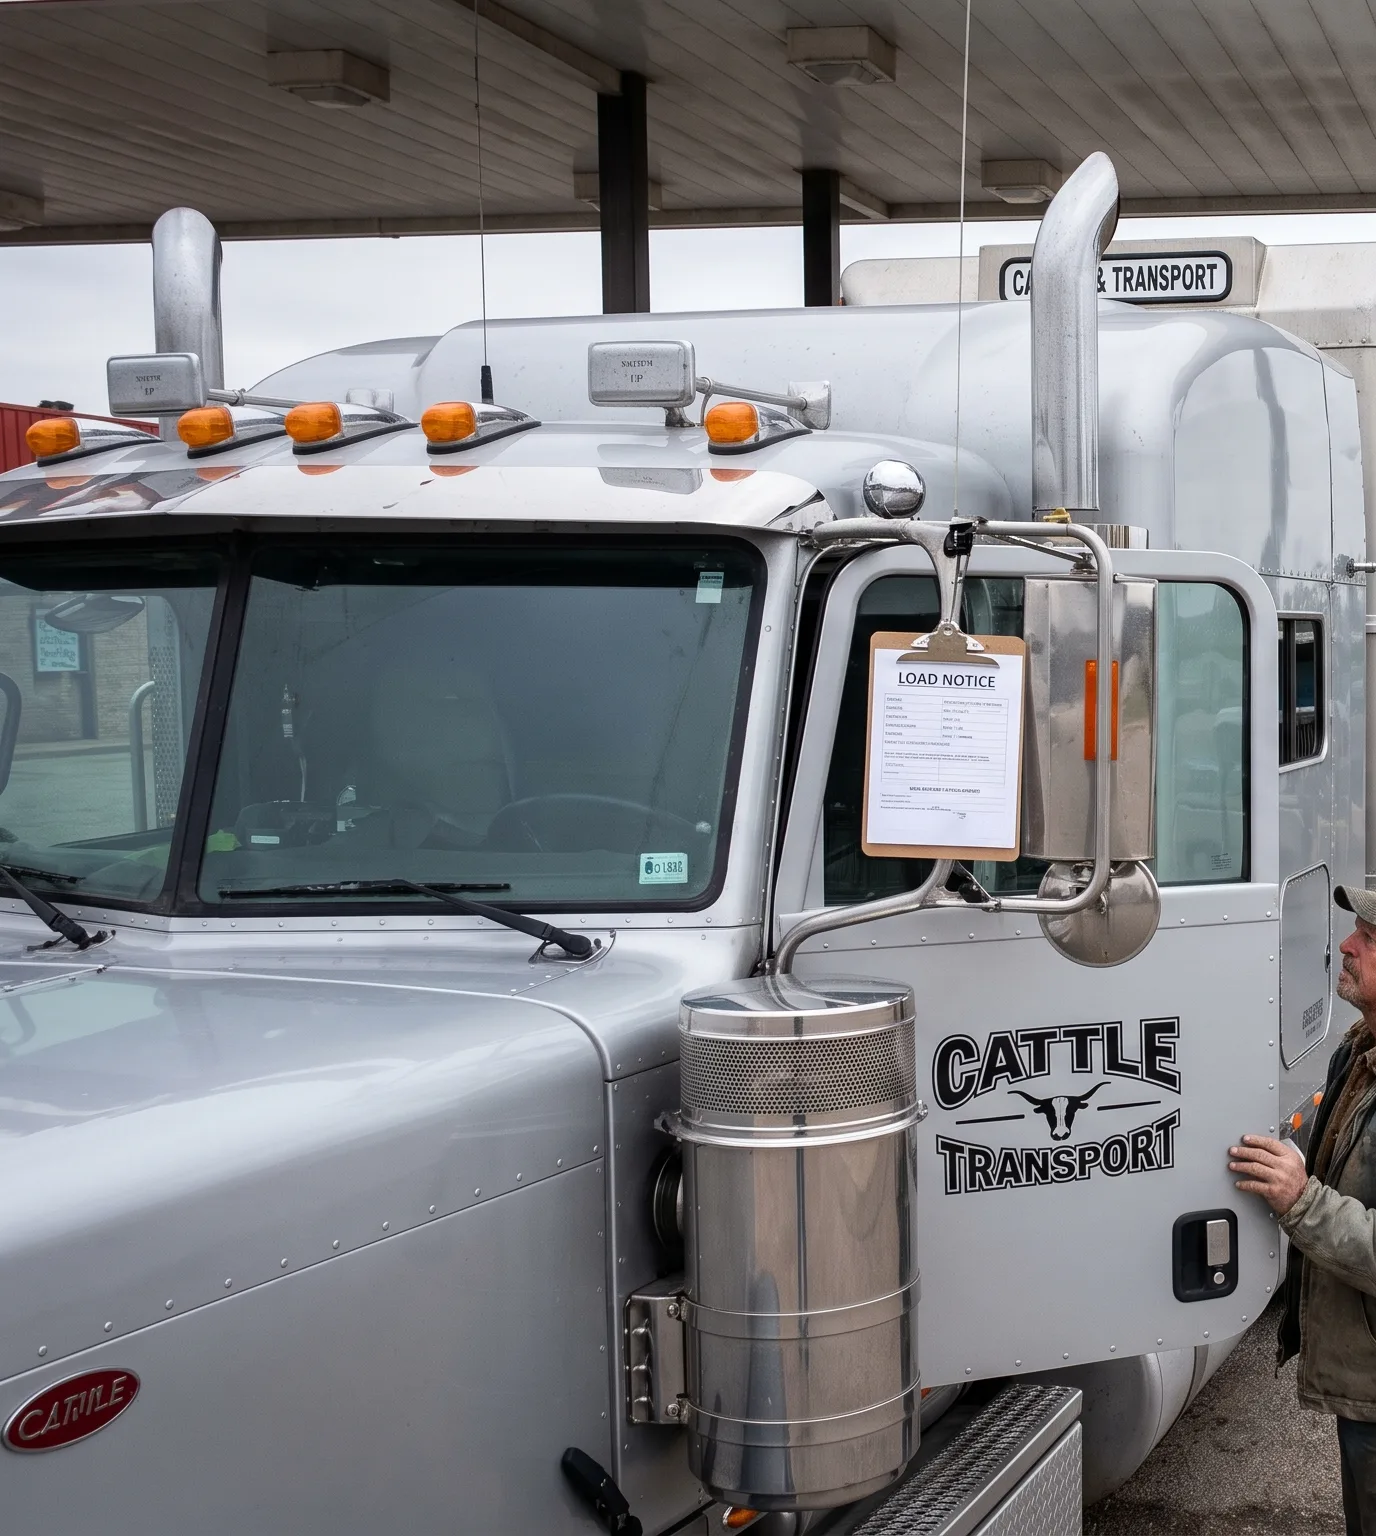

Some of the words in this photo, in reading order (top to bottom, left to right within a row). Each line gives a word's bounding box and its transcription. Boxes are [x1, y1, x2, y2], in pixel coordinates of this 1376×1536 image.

[1112, 263, 1218, 292] TRANSPORT
[898, 671, 938, 685] LOAD
[942, 674, 996, 688] NOTICE
[932, 1016, 1181, 1110] CATTLE
[936, 1108, 1180, 1195] TRANSPORT
